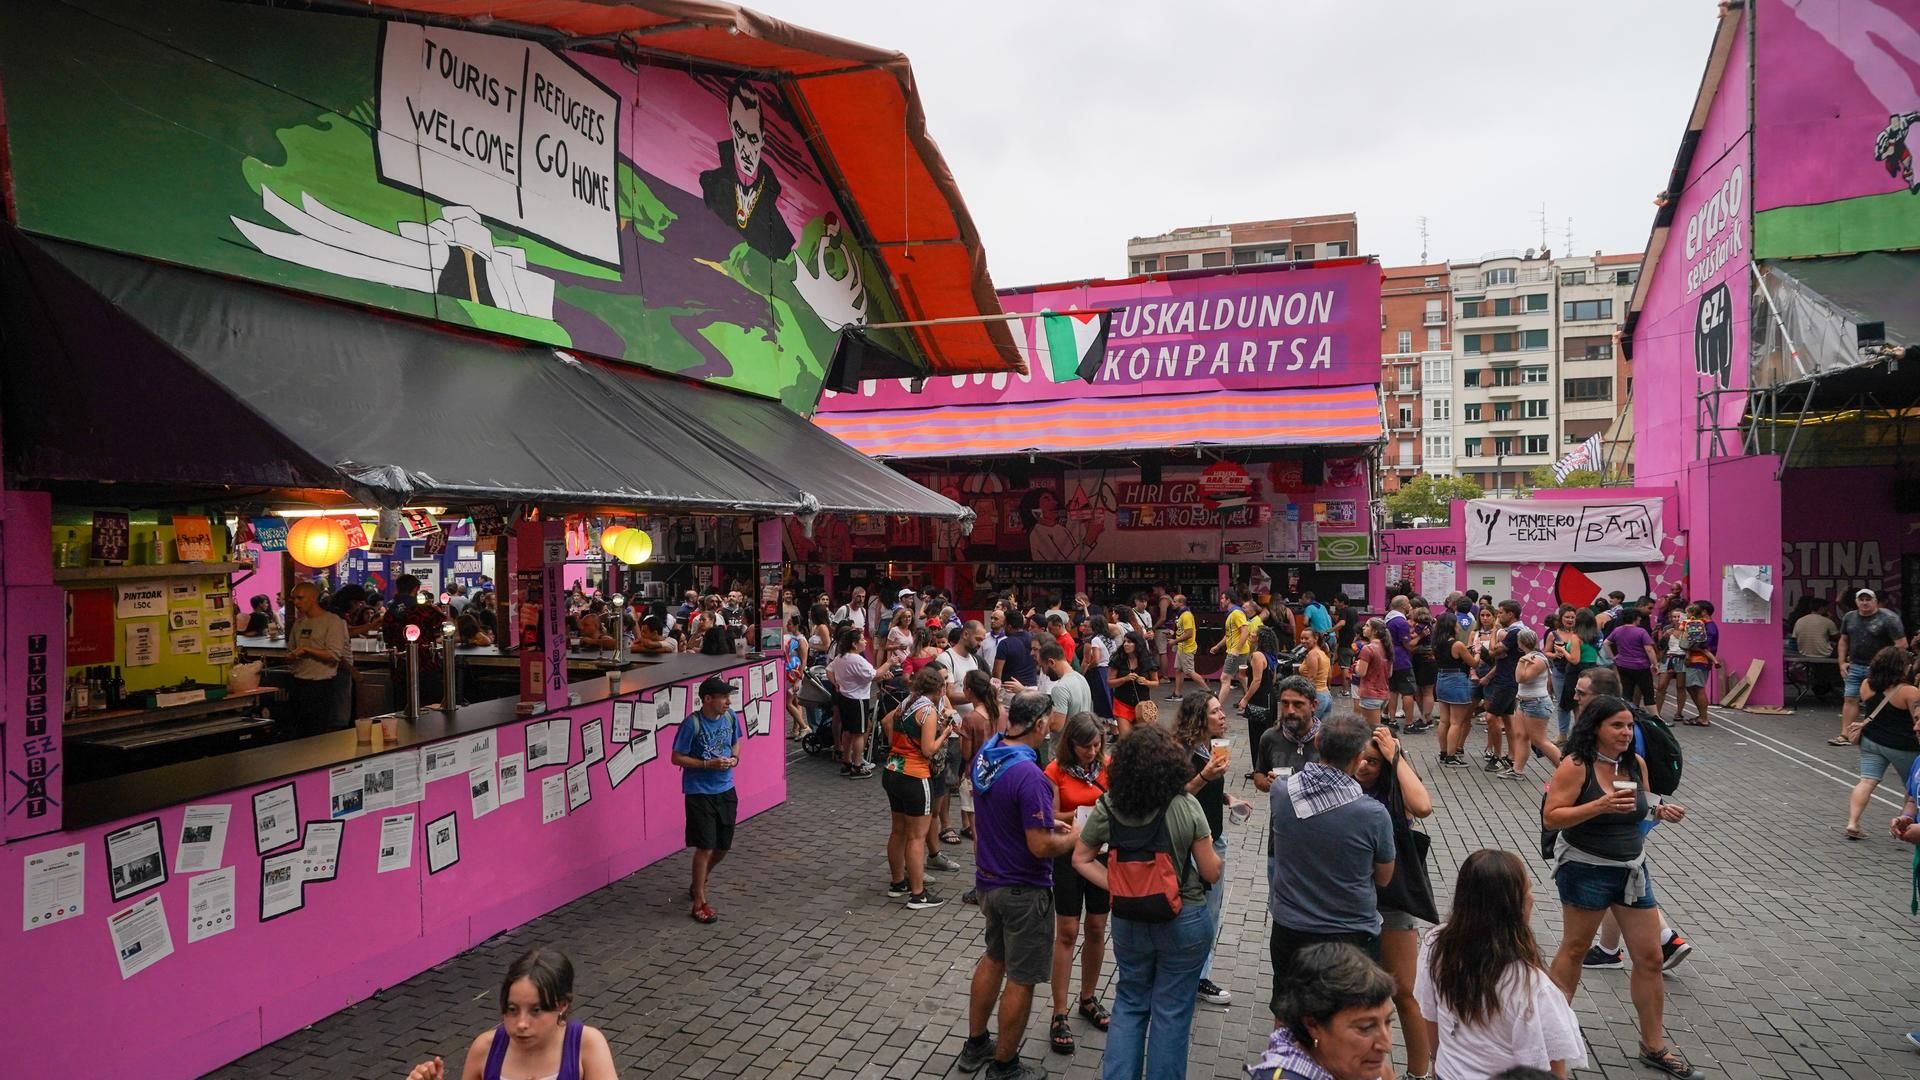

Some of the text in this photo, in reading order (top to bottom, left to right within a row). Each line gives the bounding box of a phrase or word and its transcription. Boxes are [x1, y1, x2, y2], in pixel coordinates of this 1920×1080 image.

[425, 38, 517, 113] TOURIST
[534, 72, 604, 145] REFUGEES
[406, 96, 515, 175] WELCOME
[535, 134, 610, 212] GO HOME
[1685, 164, 1744, 261] eraso
[1701, 287, 1726, 335] ez!
[1103, 336, 1332, 381] KONPARTSA
[1125, 484, 1163, 504] HIRI
[1508, 514, 1575, 528] MANTERO
[1585, 514, 1649, 543] BAT!
[123, 590, 163, 601] PINTXOAK
[27, 635, 47, 736] TIKET
[23, 736, 57, 757] EZ
